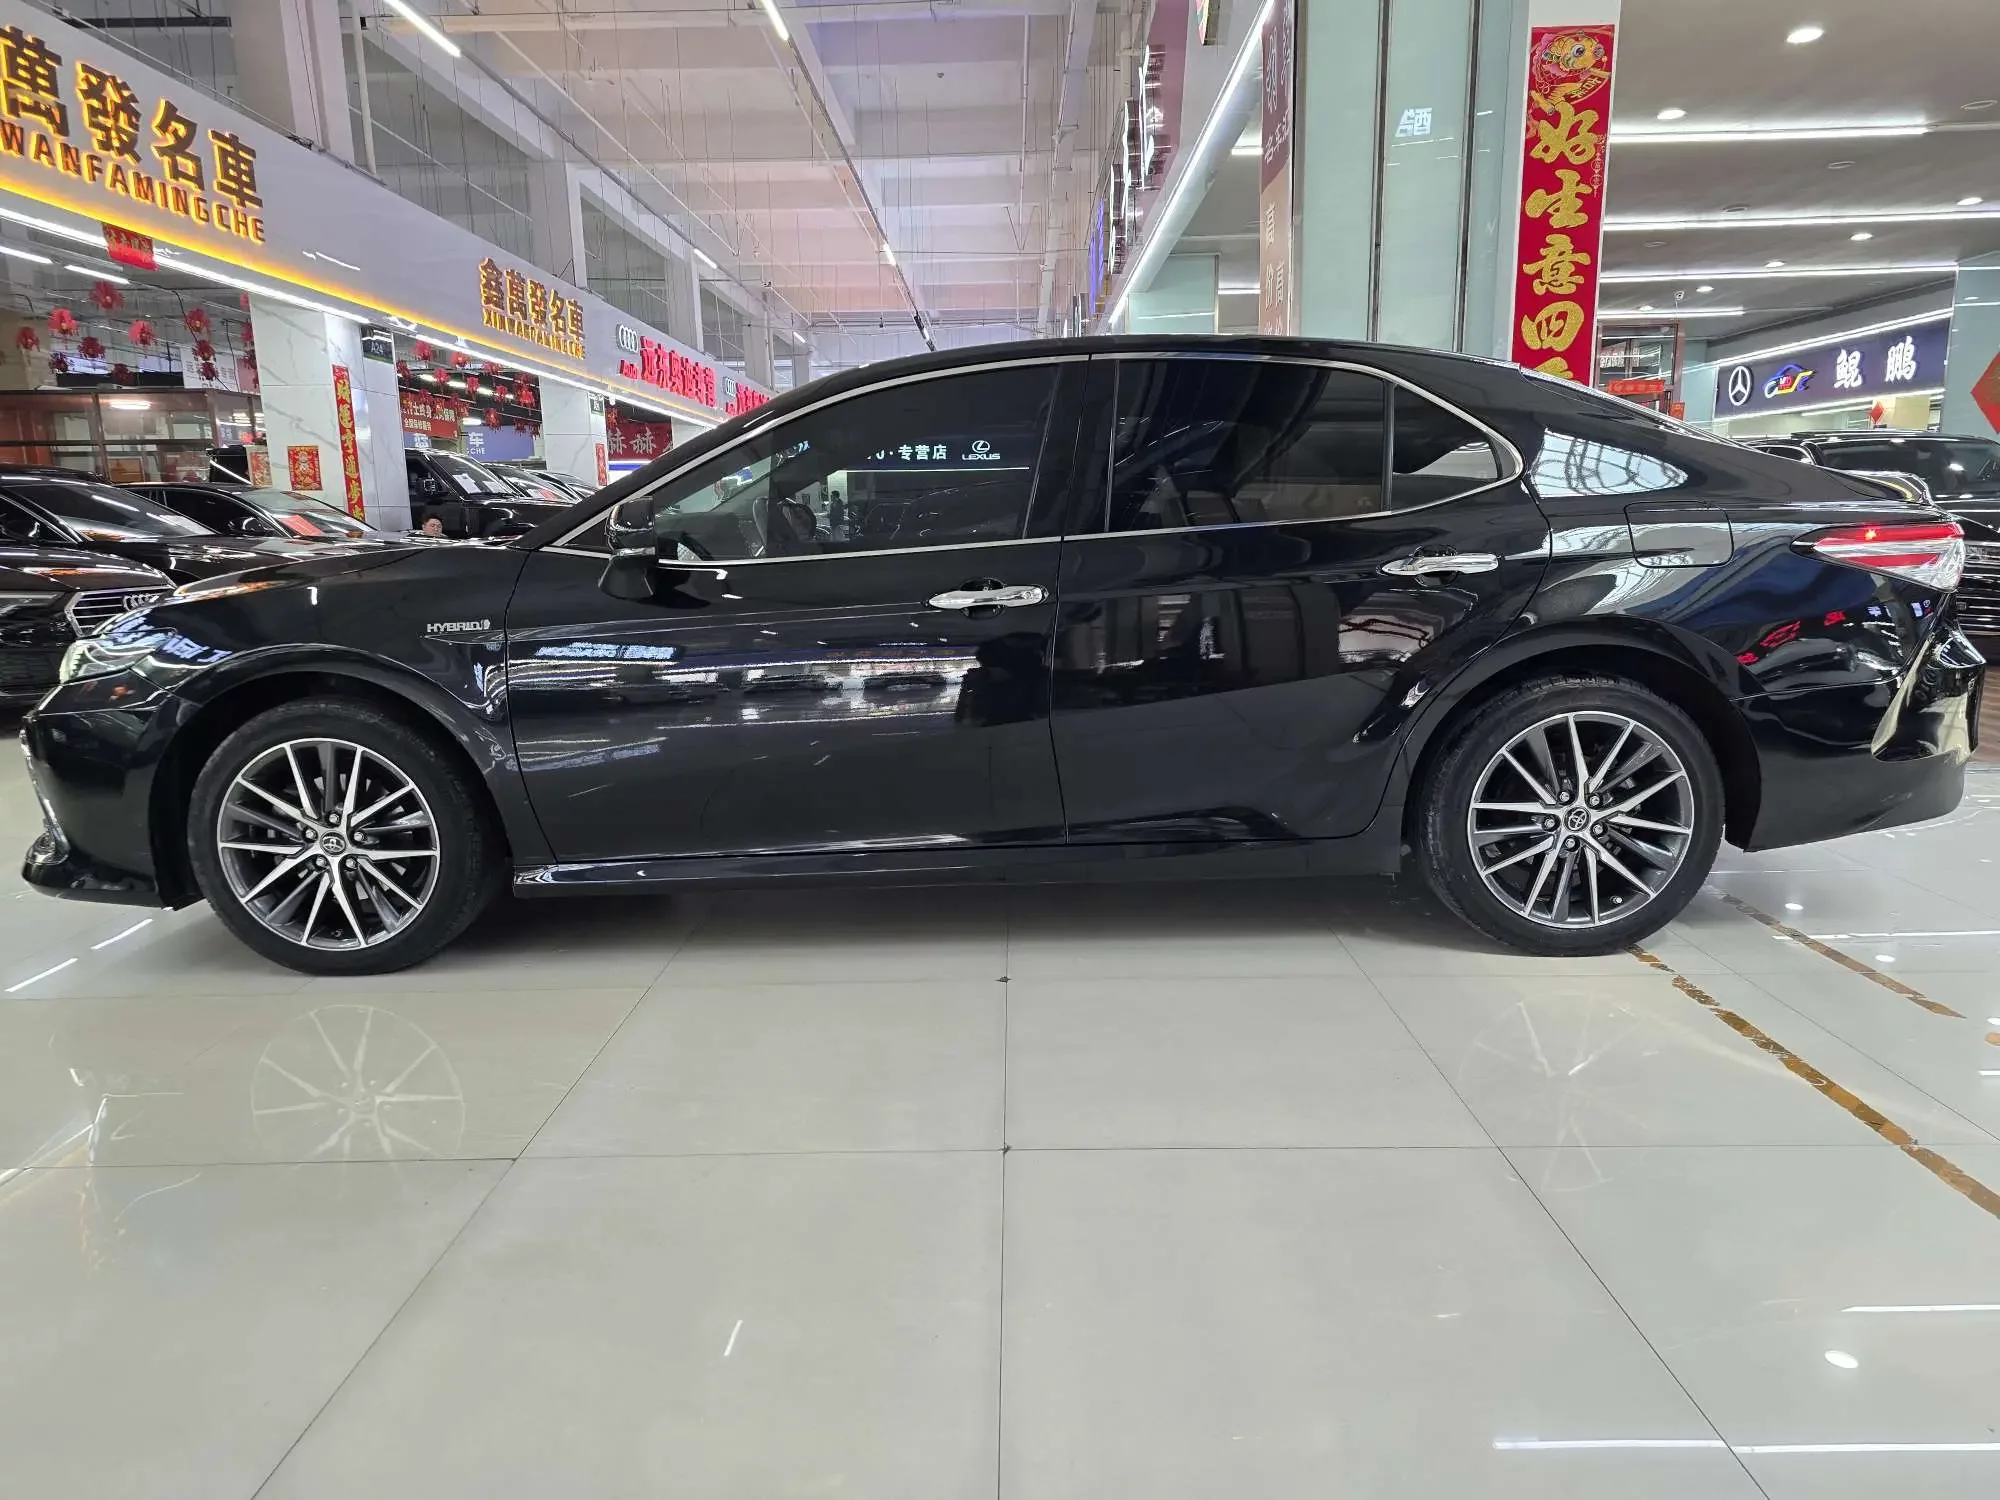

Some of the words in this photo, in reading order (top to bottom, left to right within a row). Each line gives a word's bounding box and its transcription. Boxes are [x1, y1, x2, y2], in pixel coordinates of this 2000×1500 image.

[0, 117, 266, 243] WANFAMINGCHE
[1833, 335, 1916, 391] 鲲鹏
[961, 453, 1001, 461] LEXUS
